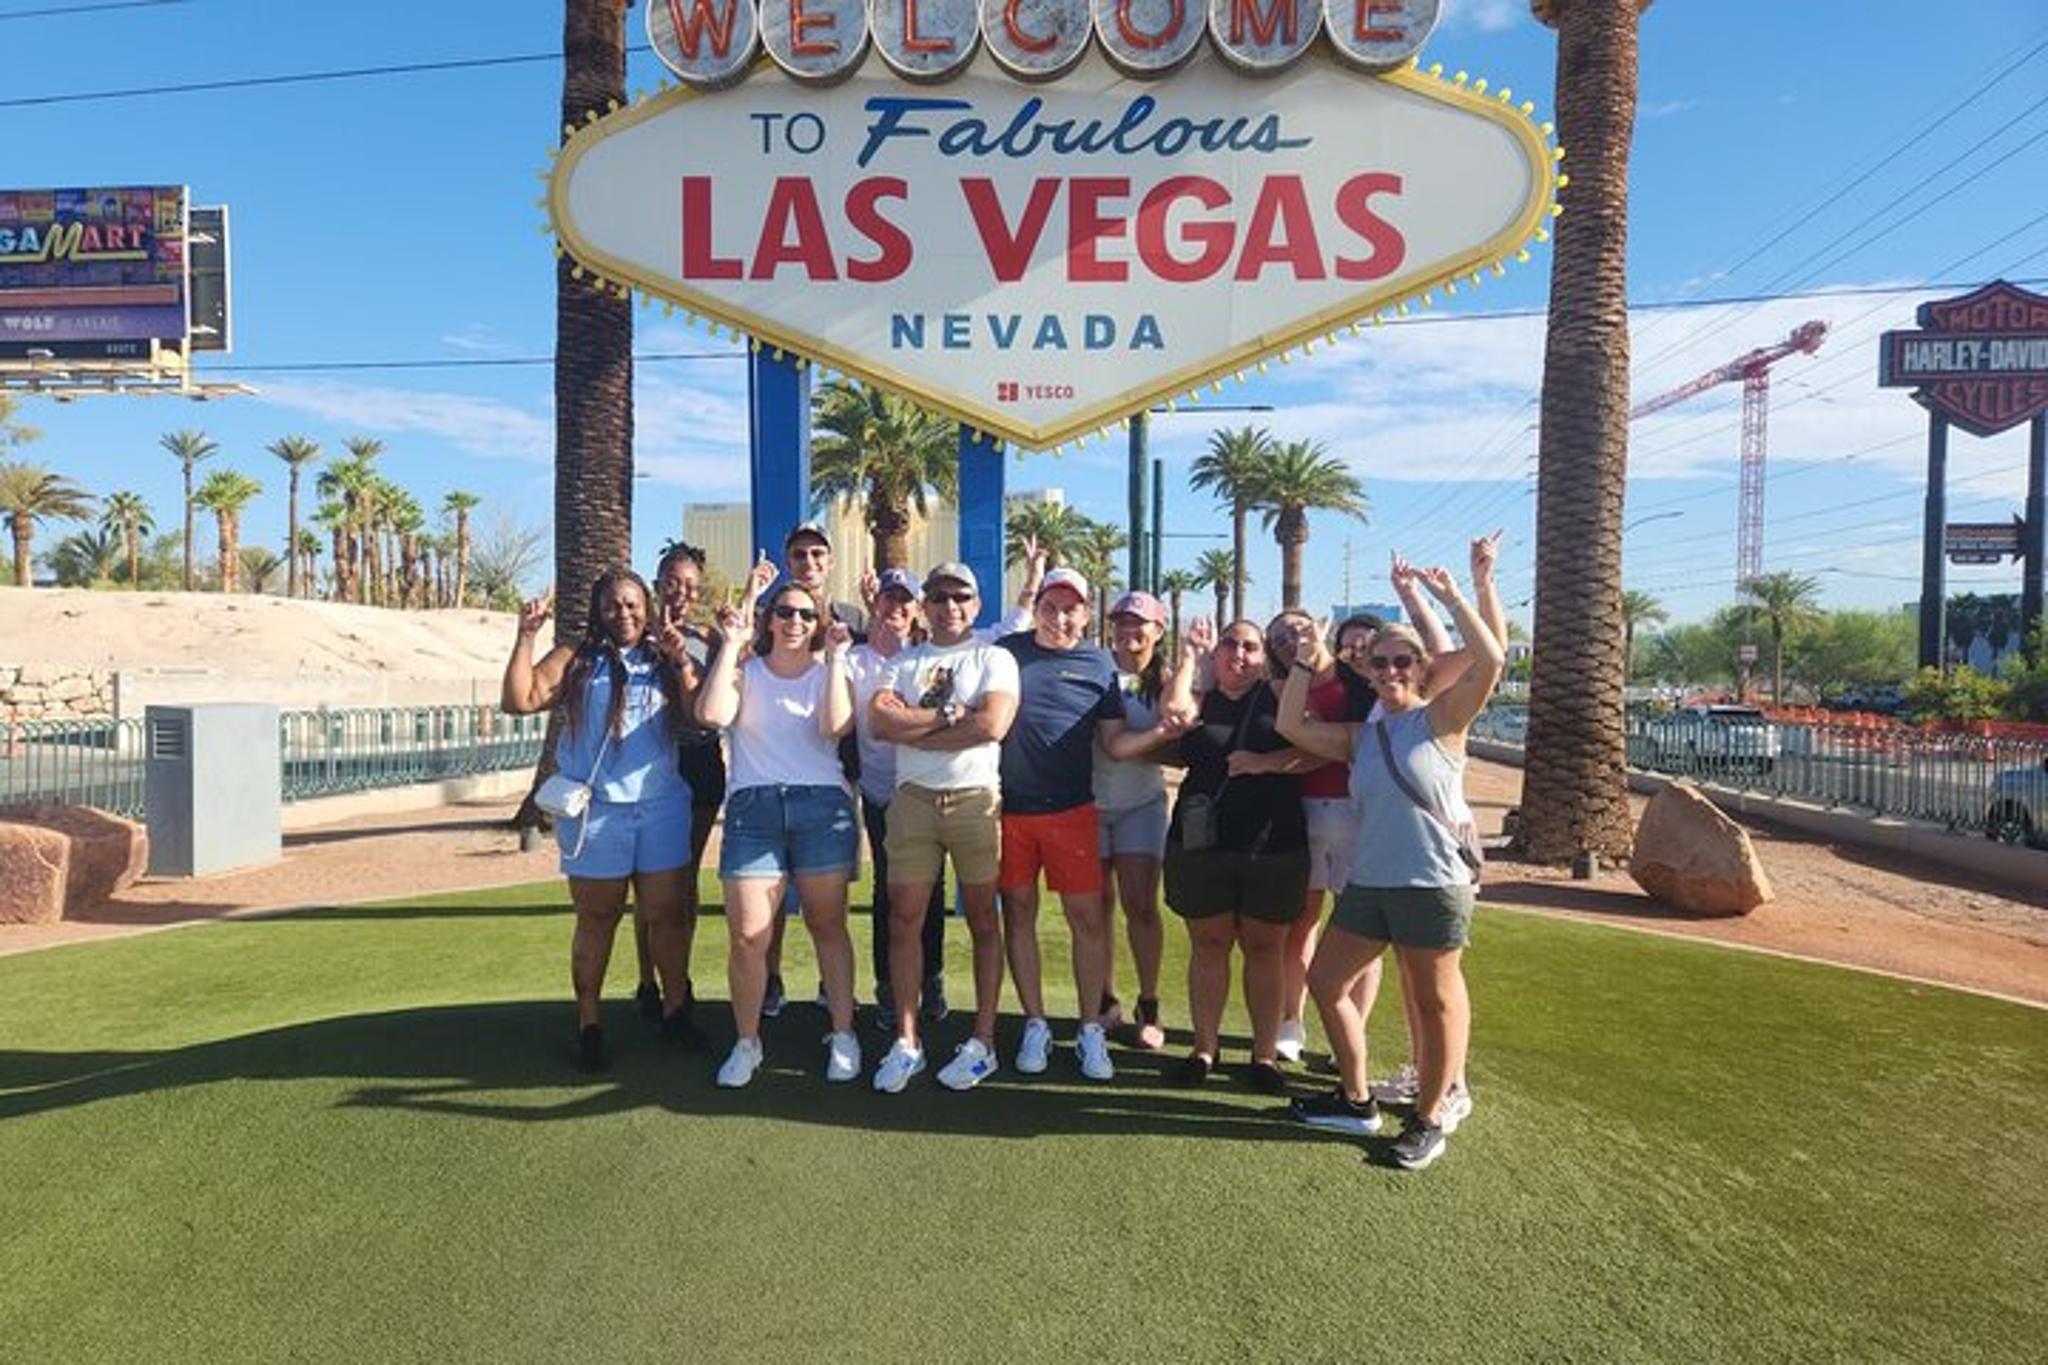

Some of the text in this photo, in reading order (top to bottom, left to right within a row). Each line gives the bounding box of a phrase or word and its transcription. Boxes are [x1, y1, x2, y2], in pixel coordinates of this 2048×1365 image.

[668, 0, 1405, 59] WELCOME
[750, 96, 1312, 169] TO Fabulous
[681, 172, 1407, 284] LAS VEGAS
[890, 313, 1164, 352] NEVADA
[1025, 384, 1074, 400] YESCO
